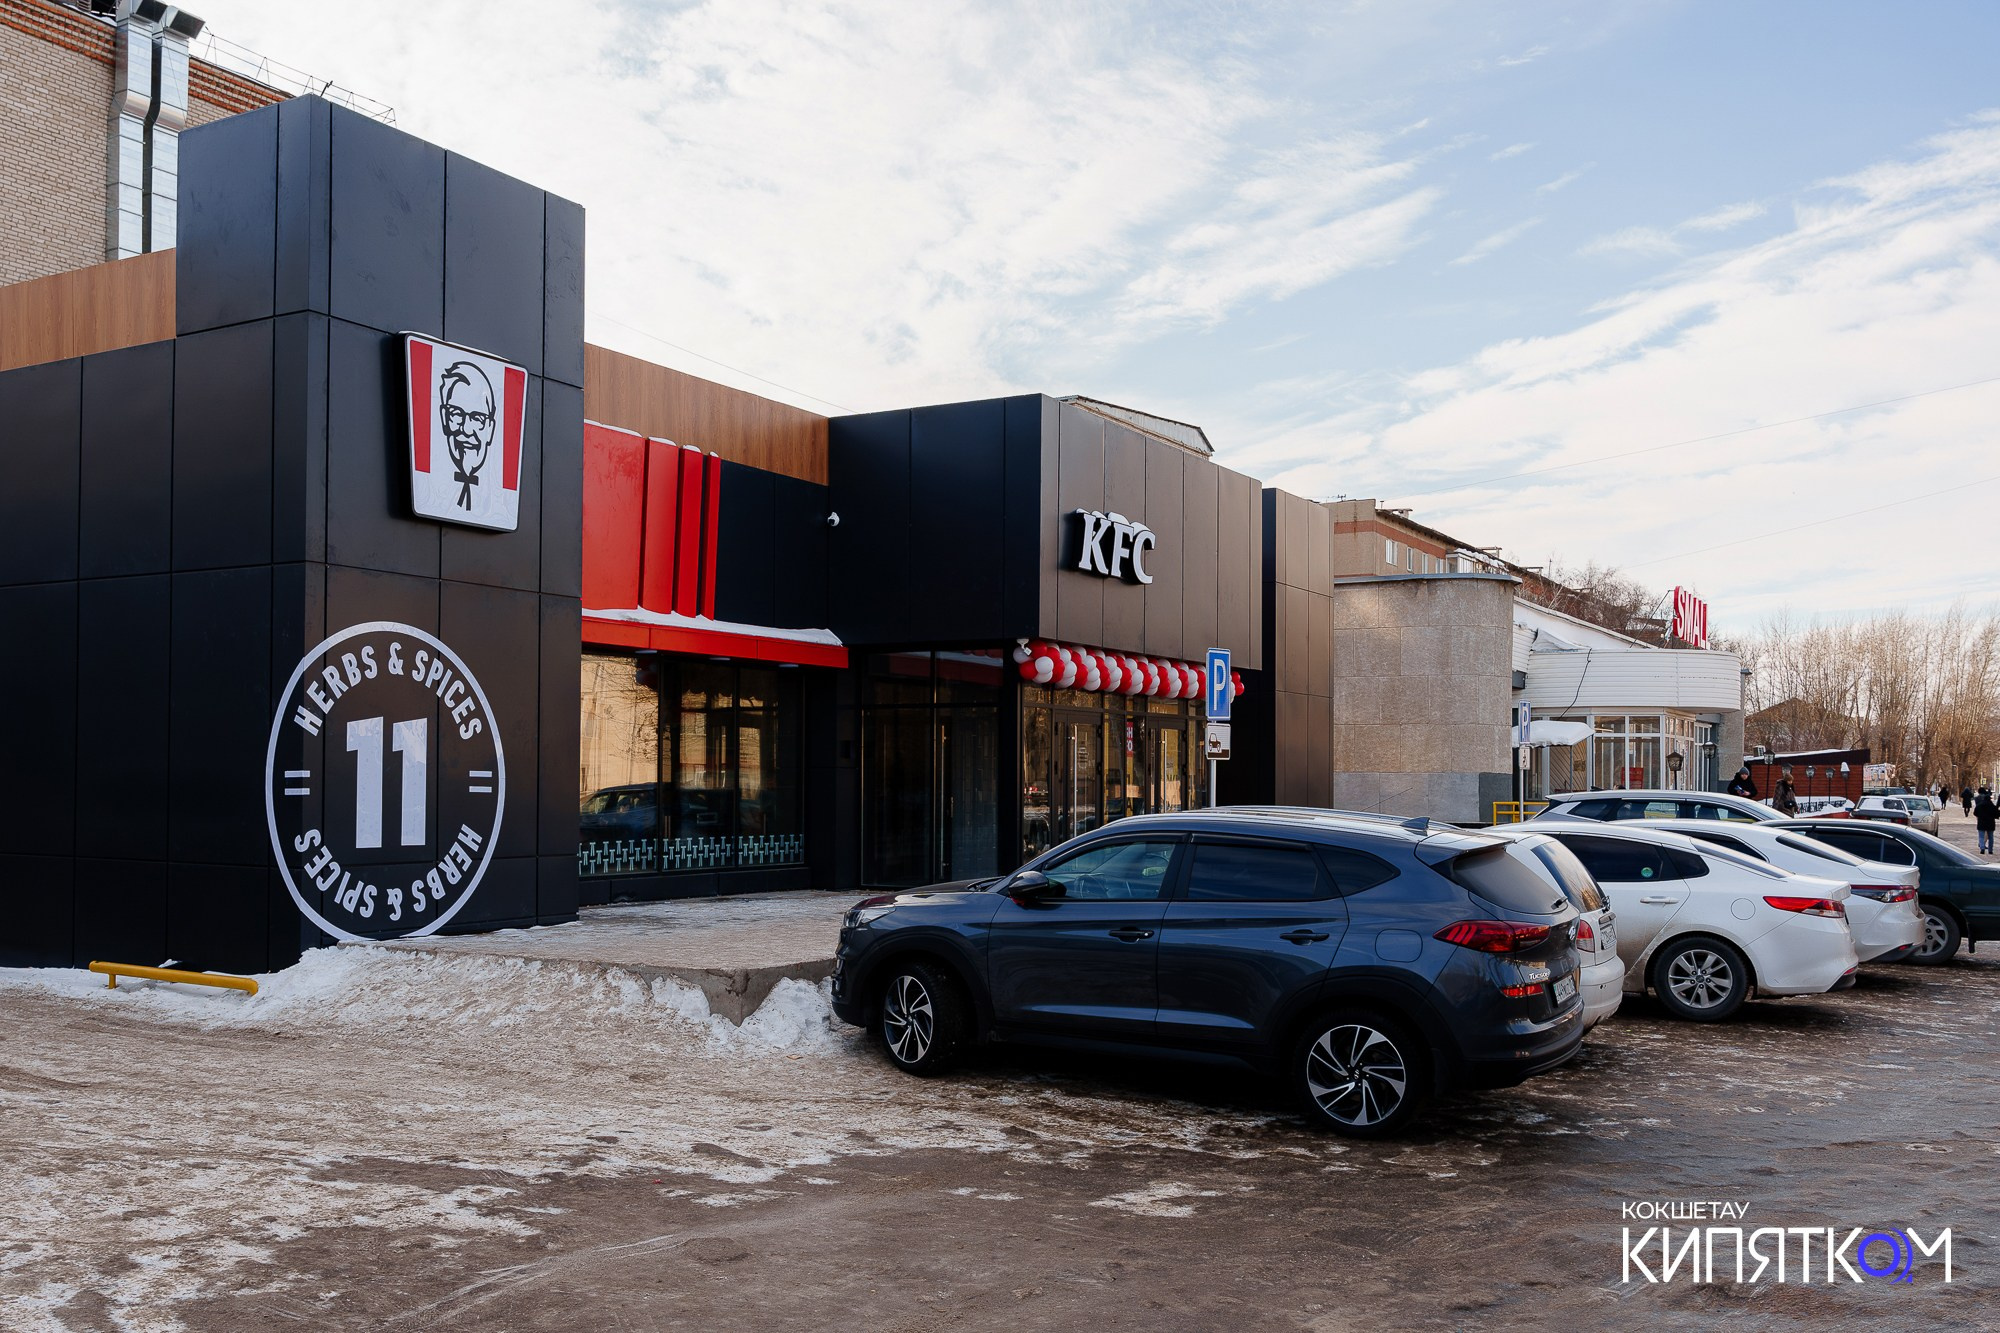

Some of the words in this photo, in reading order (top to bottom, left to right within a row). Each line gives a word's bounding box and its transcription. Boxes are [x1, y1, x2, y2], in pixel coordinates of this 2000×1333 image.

[1078, 512, 1156, 585] KFC
[1673, 585, 1711, 651] SMALL
[293, 645, 378, 737] HERBS
[388, 642, 404, 675] &
[411, 650, 483, 740] SPICES
[1214, 658, 1228, 711] P
[1522, 706, 1529, 740] P
[346, 716, 428, 849] 11
[294, 828, 378, 918] SPICES
[386, 888, 403, 921] &
[411, 823, 483, 913] HERBS
